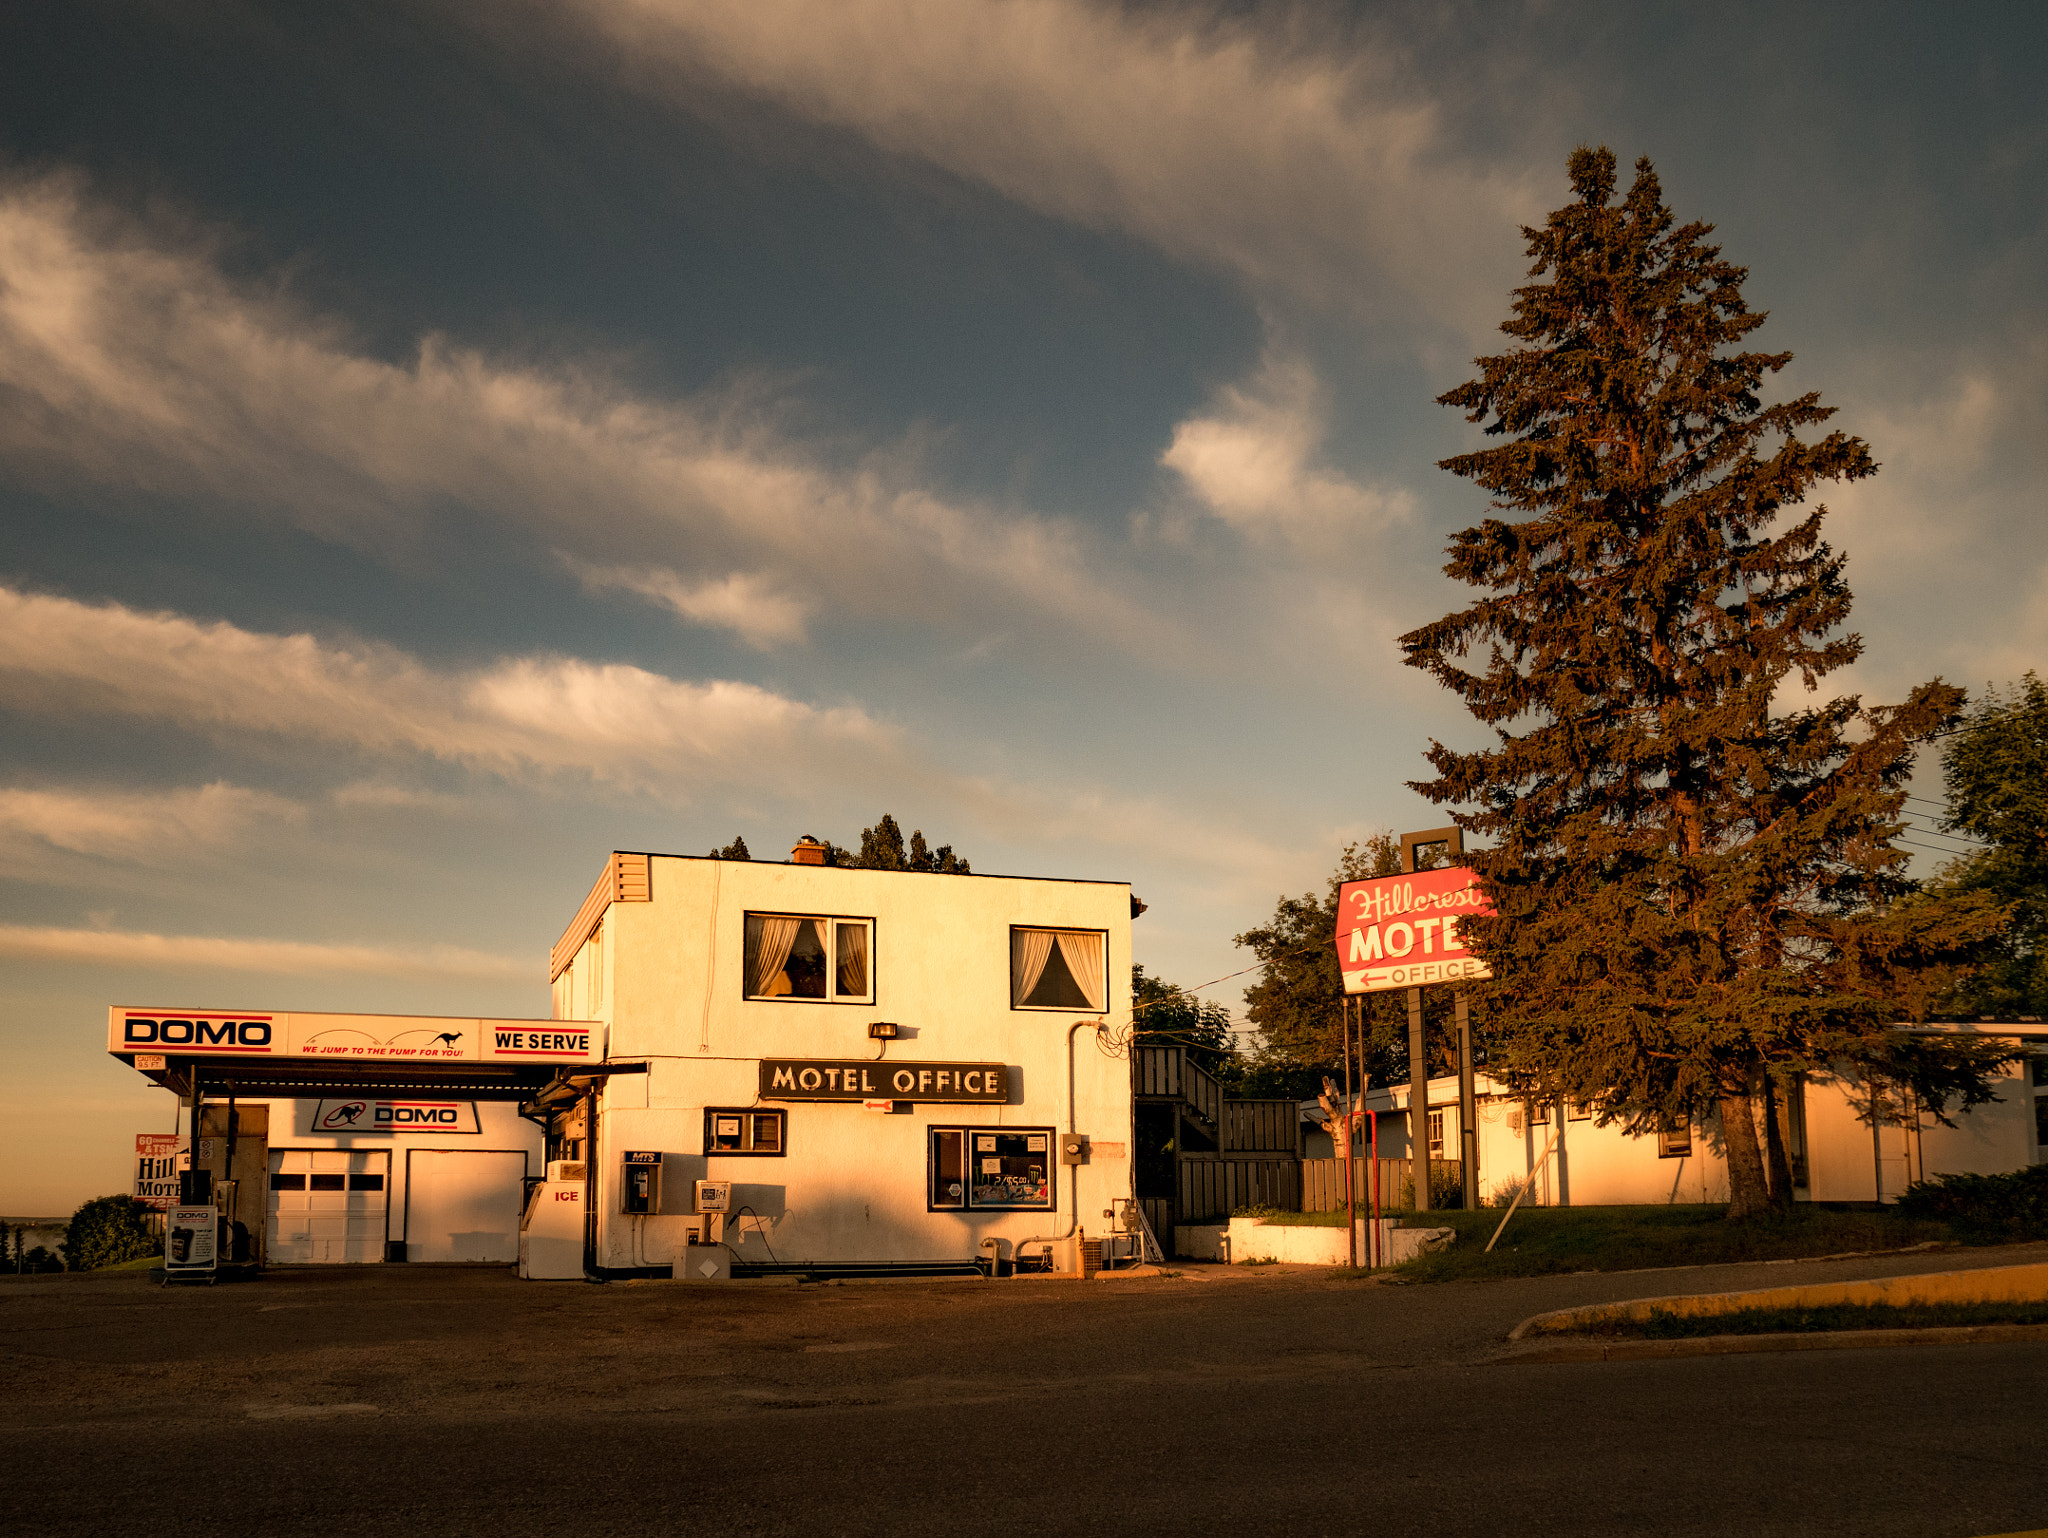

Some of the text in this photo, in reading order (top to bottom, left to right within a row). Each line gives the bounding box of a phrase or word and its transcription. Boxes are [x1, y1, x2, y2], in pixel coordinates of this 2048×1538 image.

[1349, 879, 1482, 922] Hillcrest
[1350, 914, 1482, 963] MOTE
[1392, 961, 1475, 983] OFFICE
[124, 1018, 272, 1046] DOMO
[495, 1032, 590, 1050] WE SERVE
[302, 1045, 318, 1053] WE
[320, 1046, 349, 1054] JUMP
[367, 1047, 386, 1055] THE
[388, 1048, 417, 1056] PUMP
[441, 1049, 464, 1057] YOU!
[771, 1066, 998, 1094] MOTEL OFFICE
[374, 1107, 457, 1123] DOMO
[139, 1136, 153, 1145] 60
[145, 1145, 152, 1153] &
[632, 1152, 656, 1162] MTS
[555, 1191, 579, 1202] ICE
